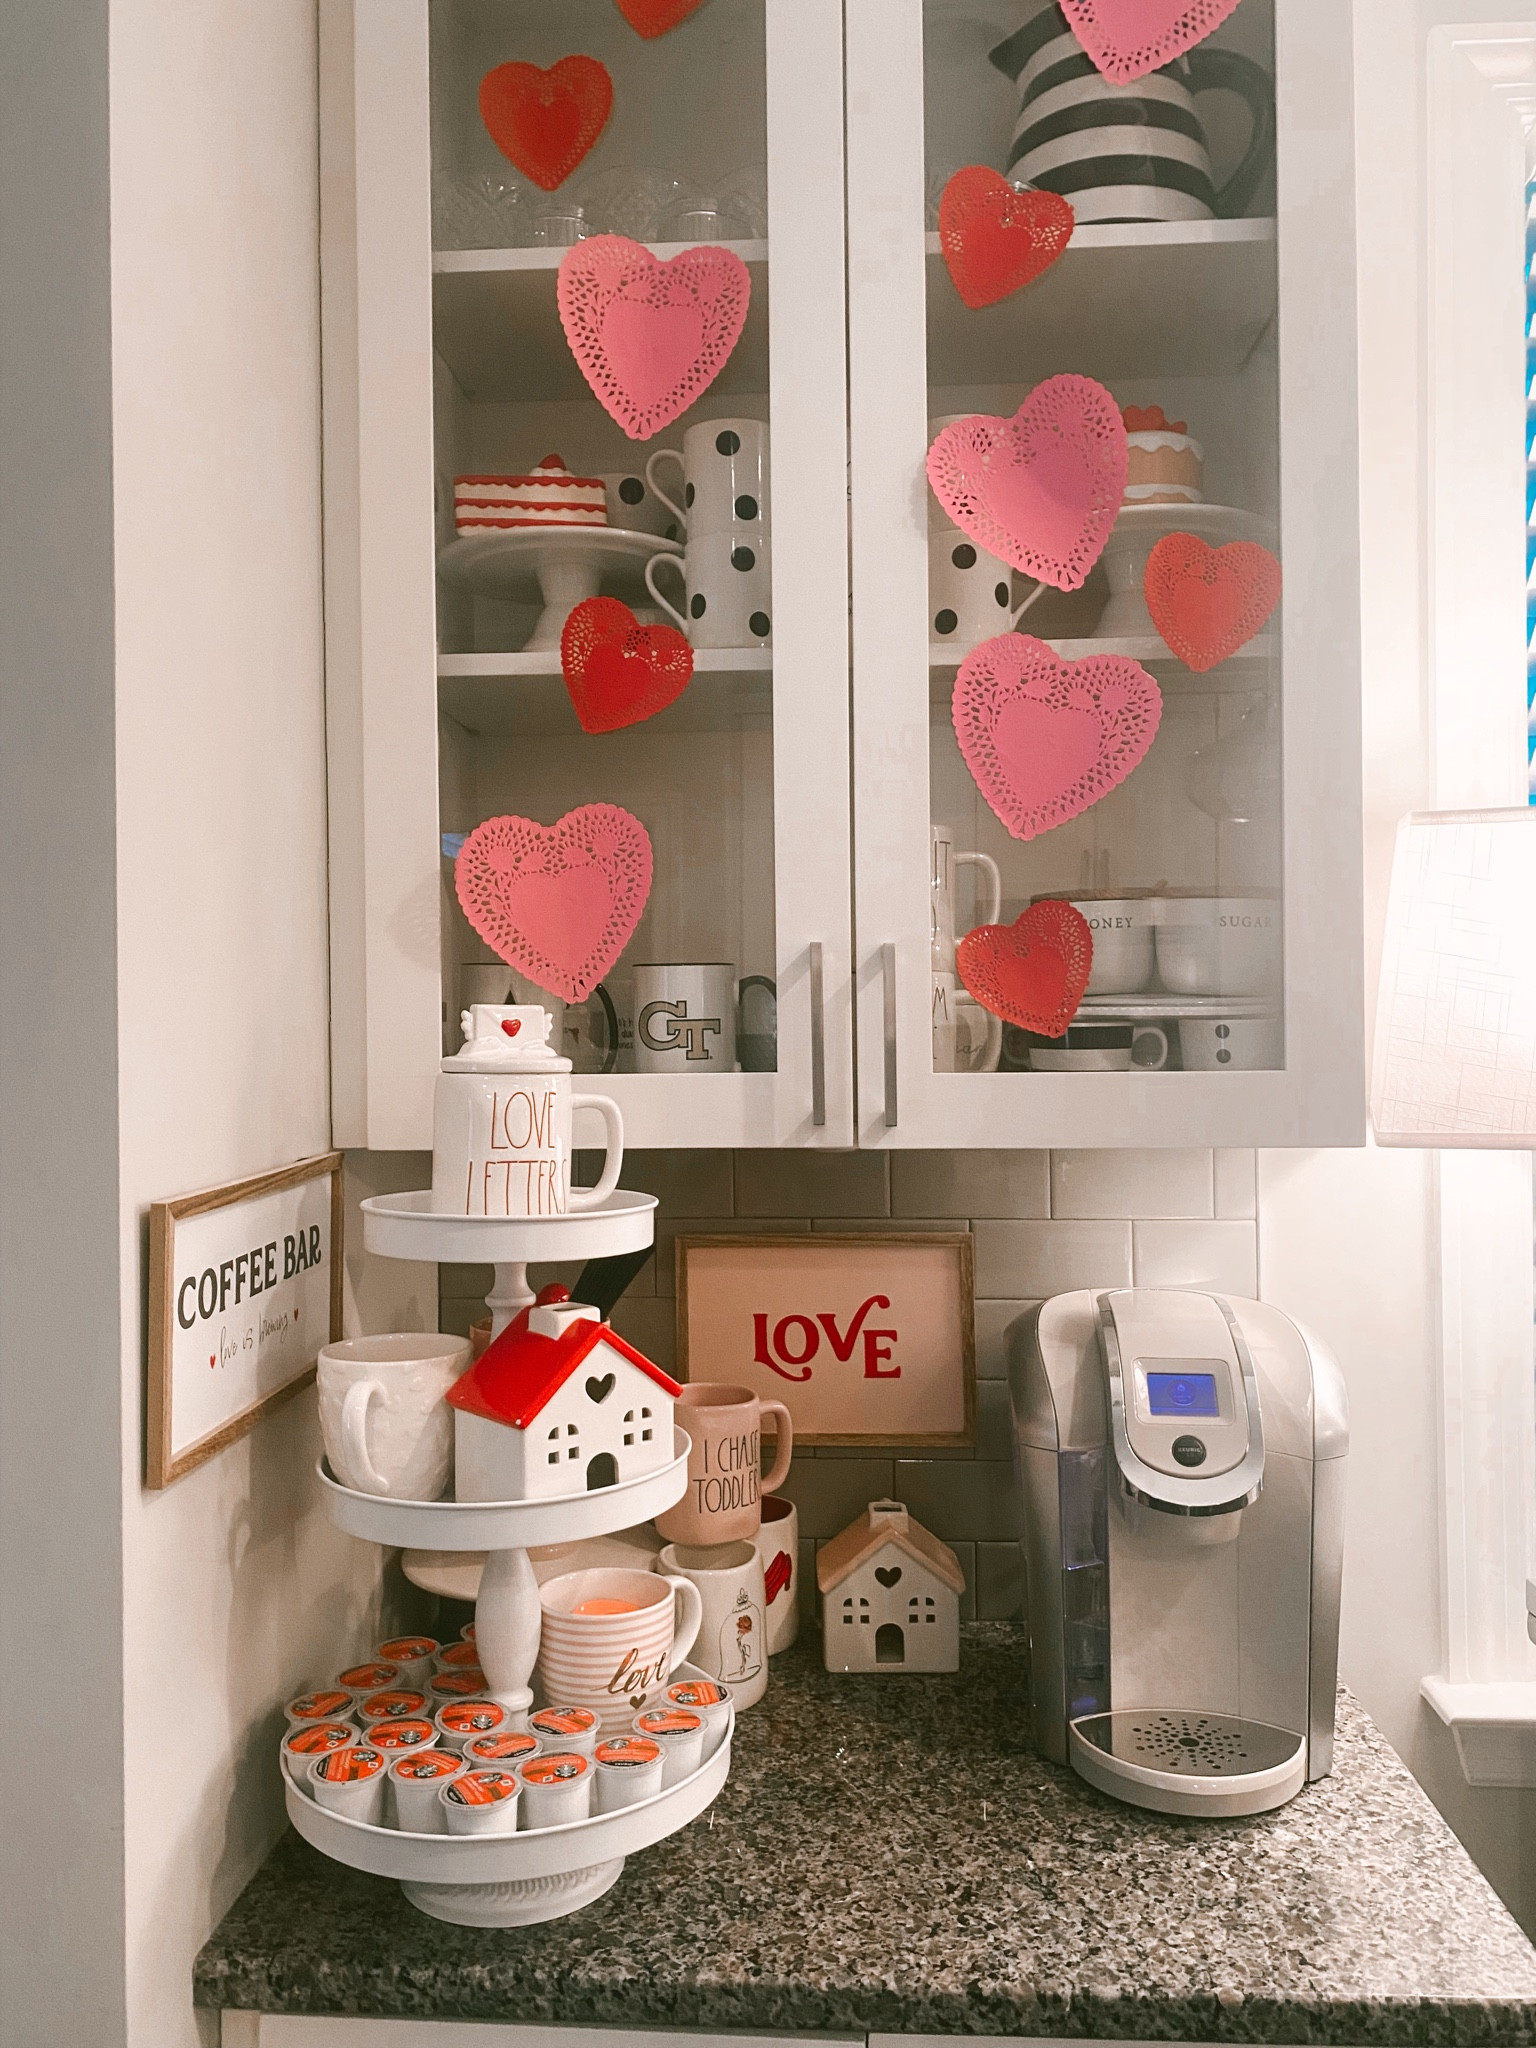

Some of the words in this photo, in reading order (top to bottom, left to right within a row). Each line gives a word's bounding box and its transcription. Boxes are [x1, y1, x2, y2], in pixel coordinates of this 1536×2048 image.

[1088, 917, 1133, 930] ONEY
[1219, 915, 1272, 928] SUGAR
[490, 1091, 557, 1150] LOVE
[177, 1240, 278, 1330] COFFEE
[283, 1224, 322, 1280] BAR
[219, 1325, 238, 1369] love
[242, 1327, 254, 1350] is
[752, 1294, 902, 1382] LOVE
[717, 1429, 758, 1472] CHASE
[589, 1647, 668, 1695] love
